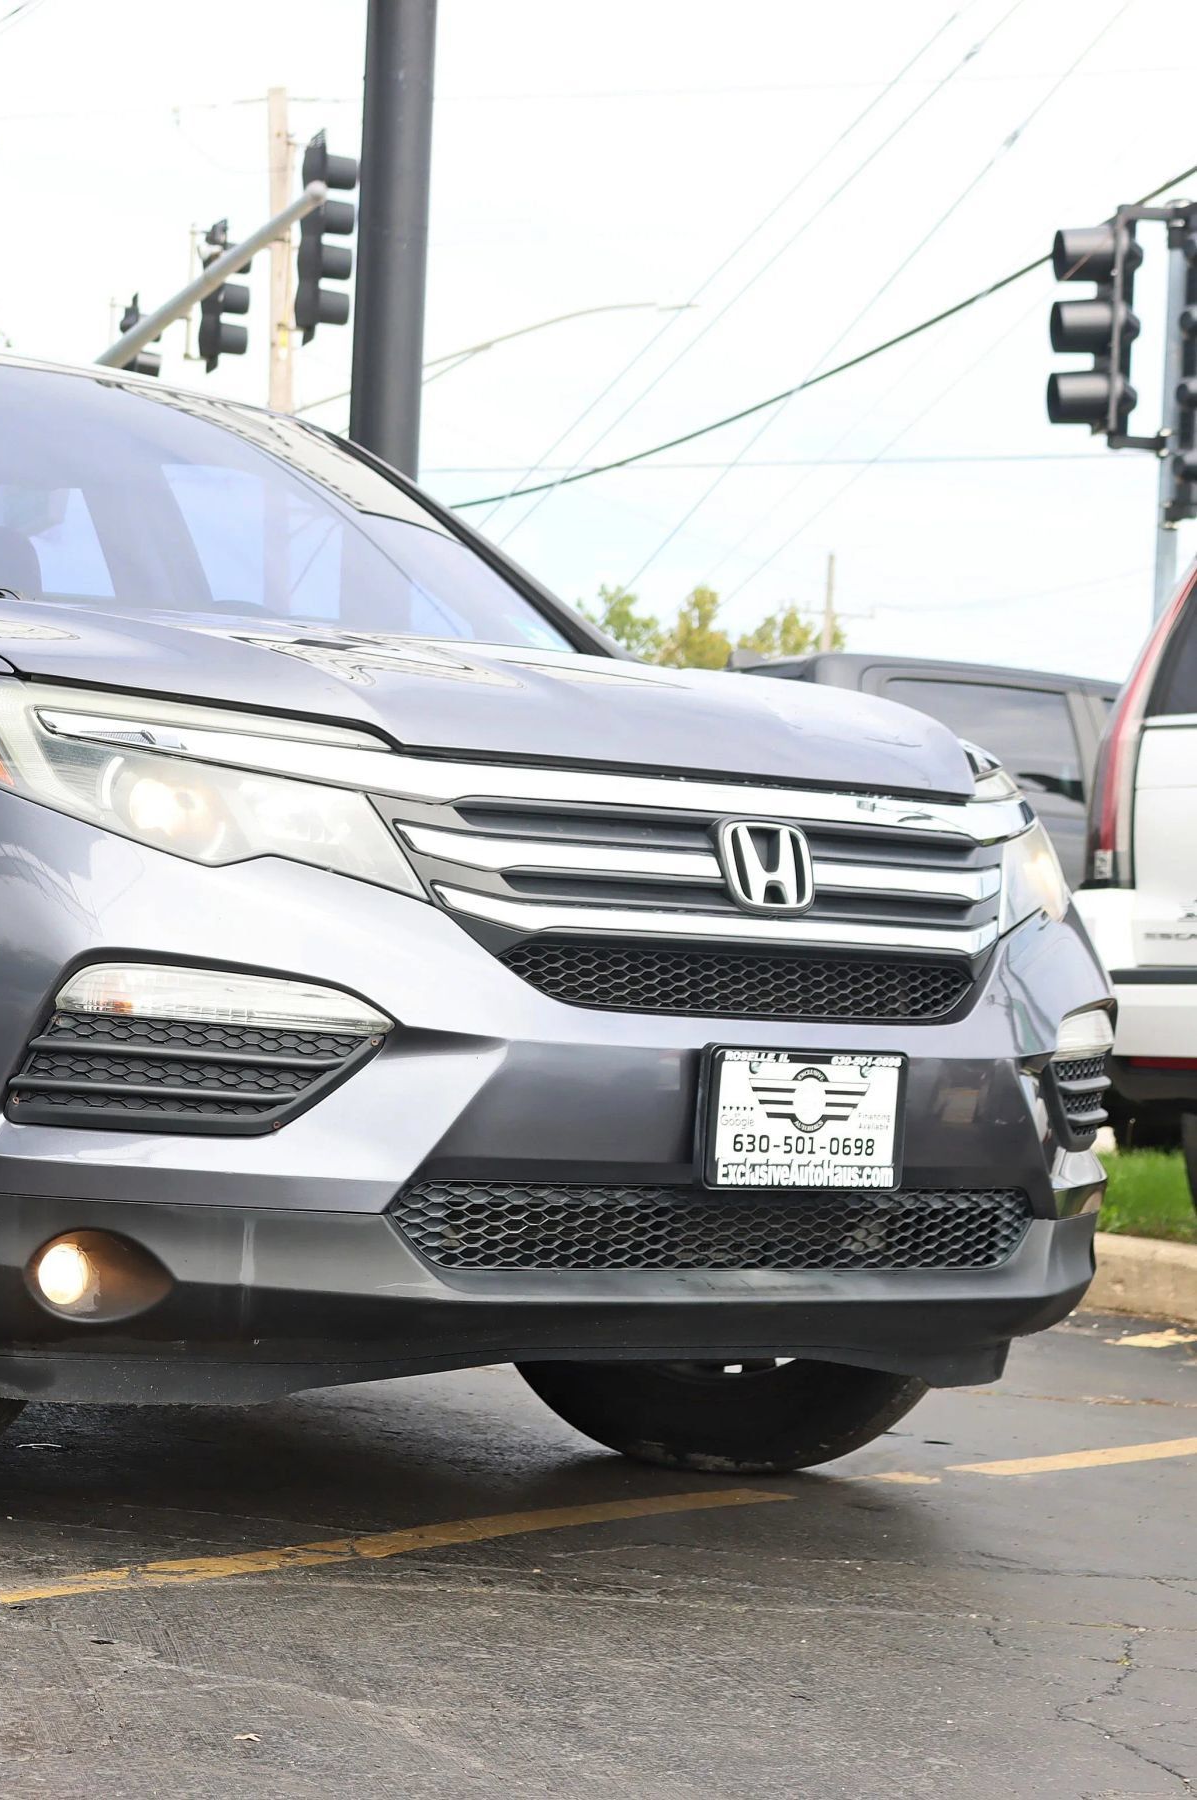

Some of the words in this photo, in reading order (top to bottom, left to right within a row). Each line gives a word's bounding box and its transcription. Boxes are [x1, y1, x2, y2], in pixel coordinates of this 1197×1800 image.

[778, 1053, 790, 1063] IL
[831, 1056, 902, 1068] 630-501-0698
[720, 1114, 755, 1130] Google
[733, 1133, 875, 1157] 630-501-0698
[717, 1158, 894, 1188] ExclusiveAutoHaus.com
